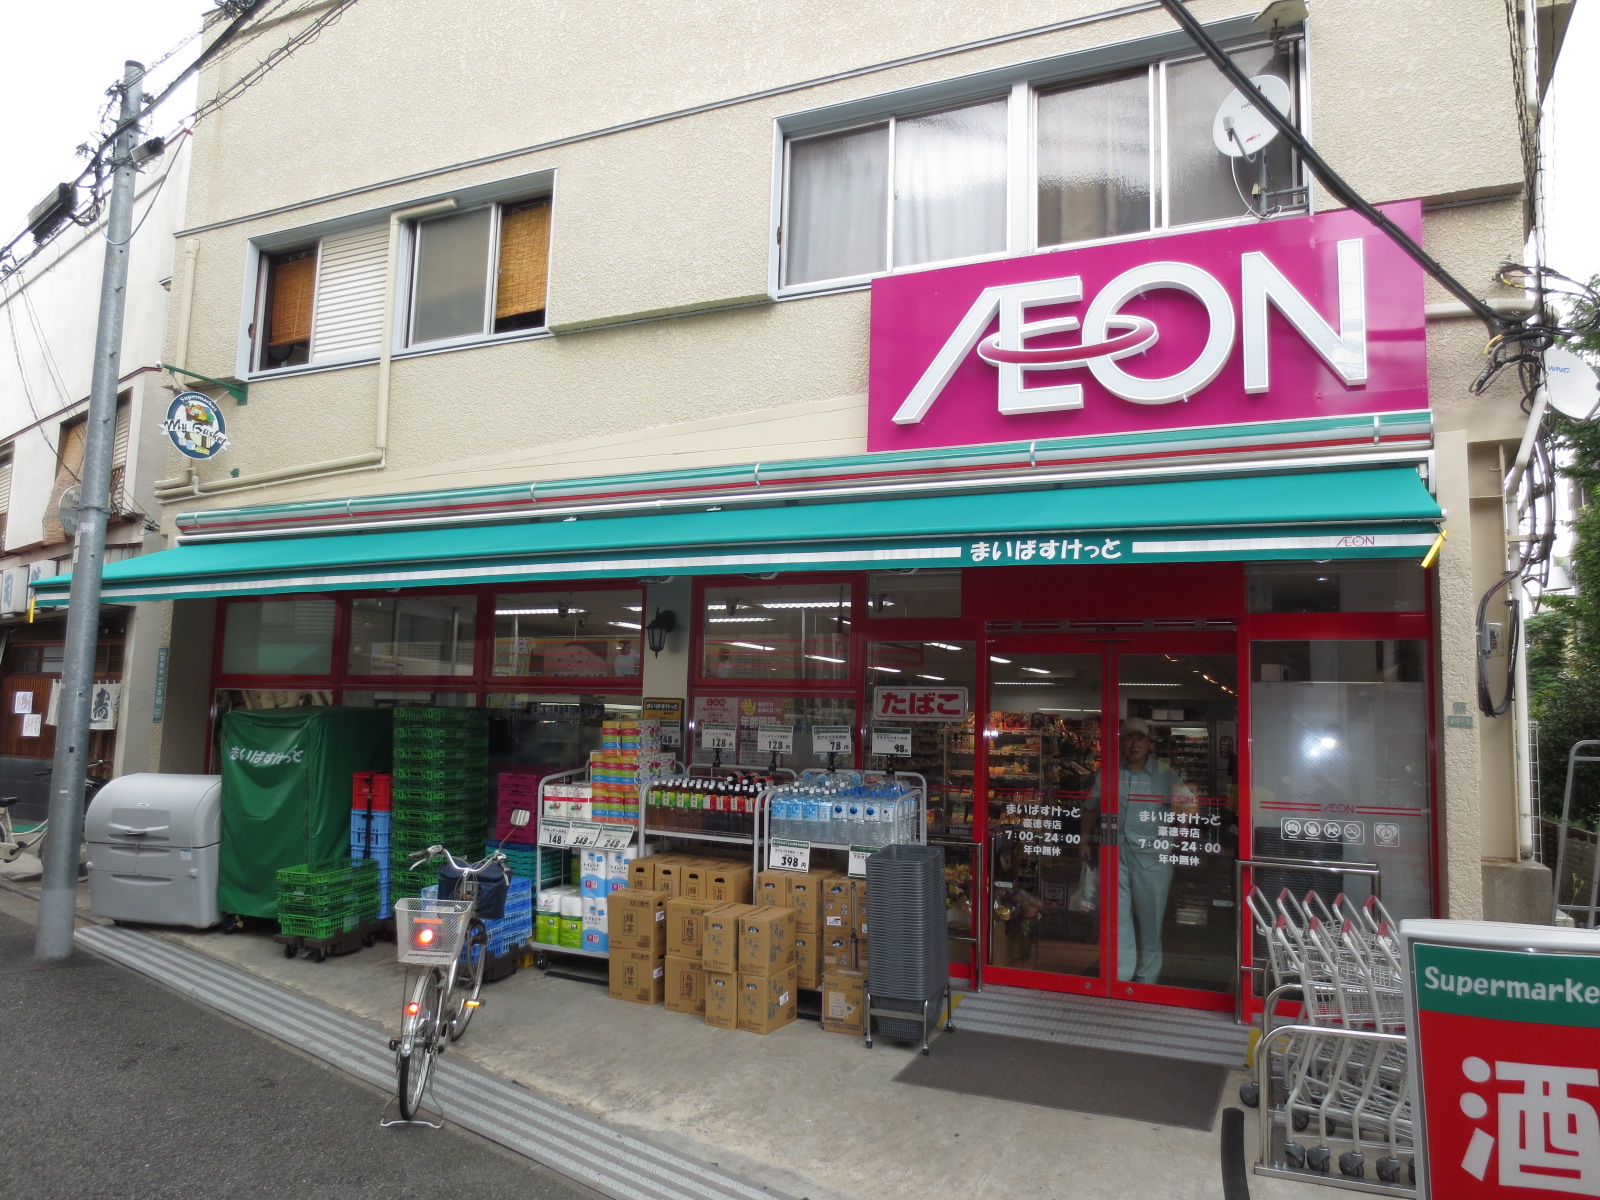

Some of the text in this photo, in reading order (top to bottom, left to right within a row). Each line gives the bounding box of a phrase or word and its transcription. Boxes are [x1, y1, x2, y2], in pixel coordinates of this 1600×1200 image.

[1547, 365, 1570, 373] WNC
[180, 395, 217, 411] Supermarket
[164, 419, 227, 445] My Basket
[970, 538, 1122, 562] まいばすけっと
[646, 702, 679, 710] まいばすけっと
[881, 692, 961, 714] たばこ
[711, 738, 727, 748] 128
[768, 740, 784, 750] 128
[829, 741, 842, 750] 78
[894, 744, 905, 753] 98
[230, 746, 304, 765] まいばすけっと
[1005, 803, 1081, 818] まいばすけっと
[1023, 818, 1062, 830] 豪徳寺店
[1139, 810, 1221, 826] まいばすけっと
[1157, 826, 1200, 838] 豪徳寺店
[548, 834, 562, 844] 148
[573, 837, 588, 845] 348
[604, 839, 621, 848] 248
[1023, 845, 1062, 856] 年中無休
[780, 856, 799, 867] 398
[1158, 853, 1200, 866] 年中無休
[626, 912, 636, 934] 緑茶
[626, 964, 636, 987] 緑茶
[1459, 1055, 1600, 1197] 酒
